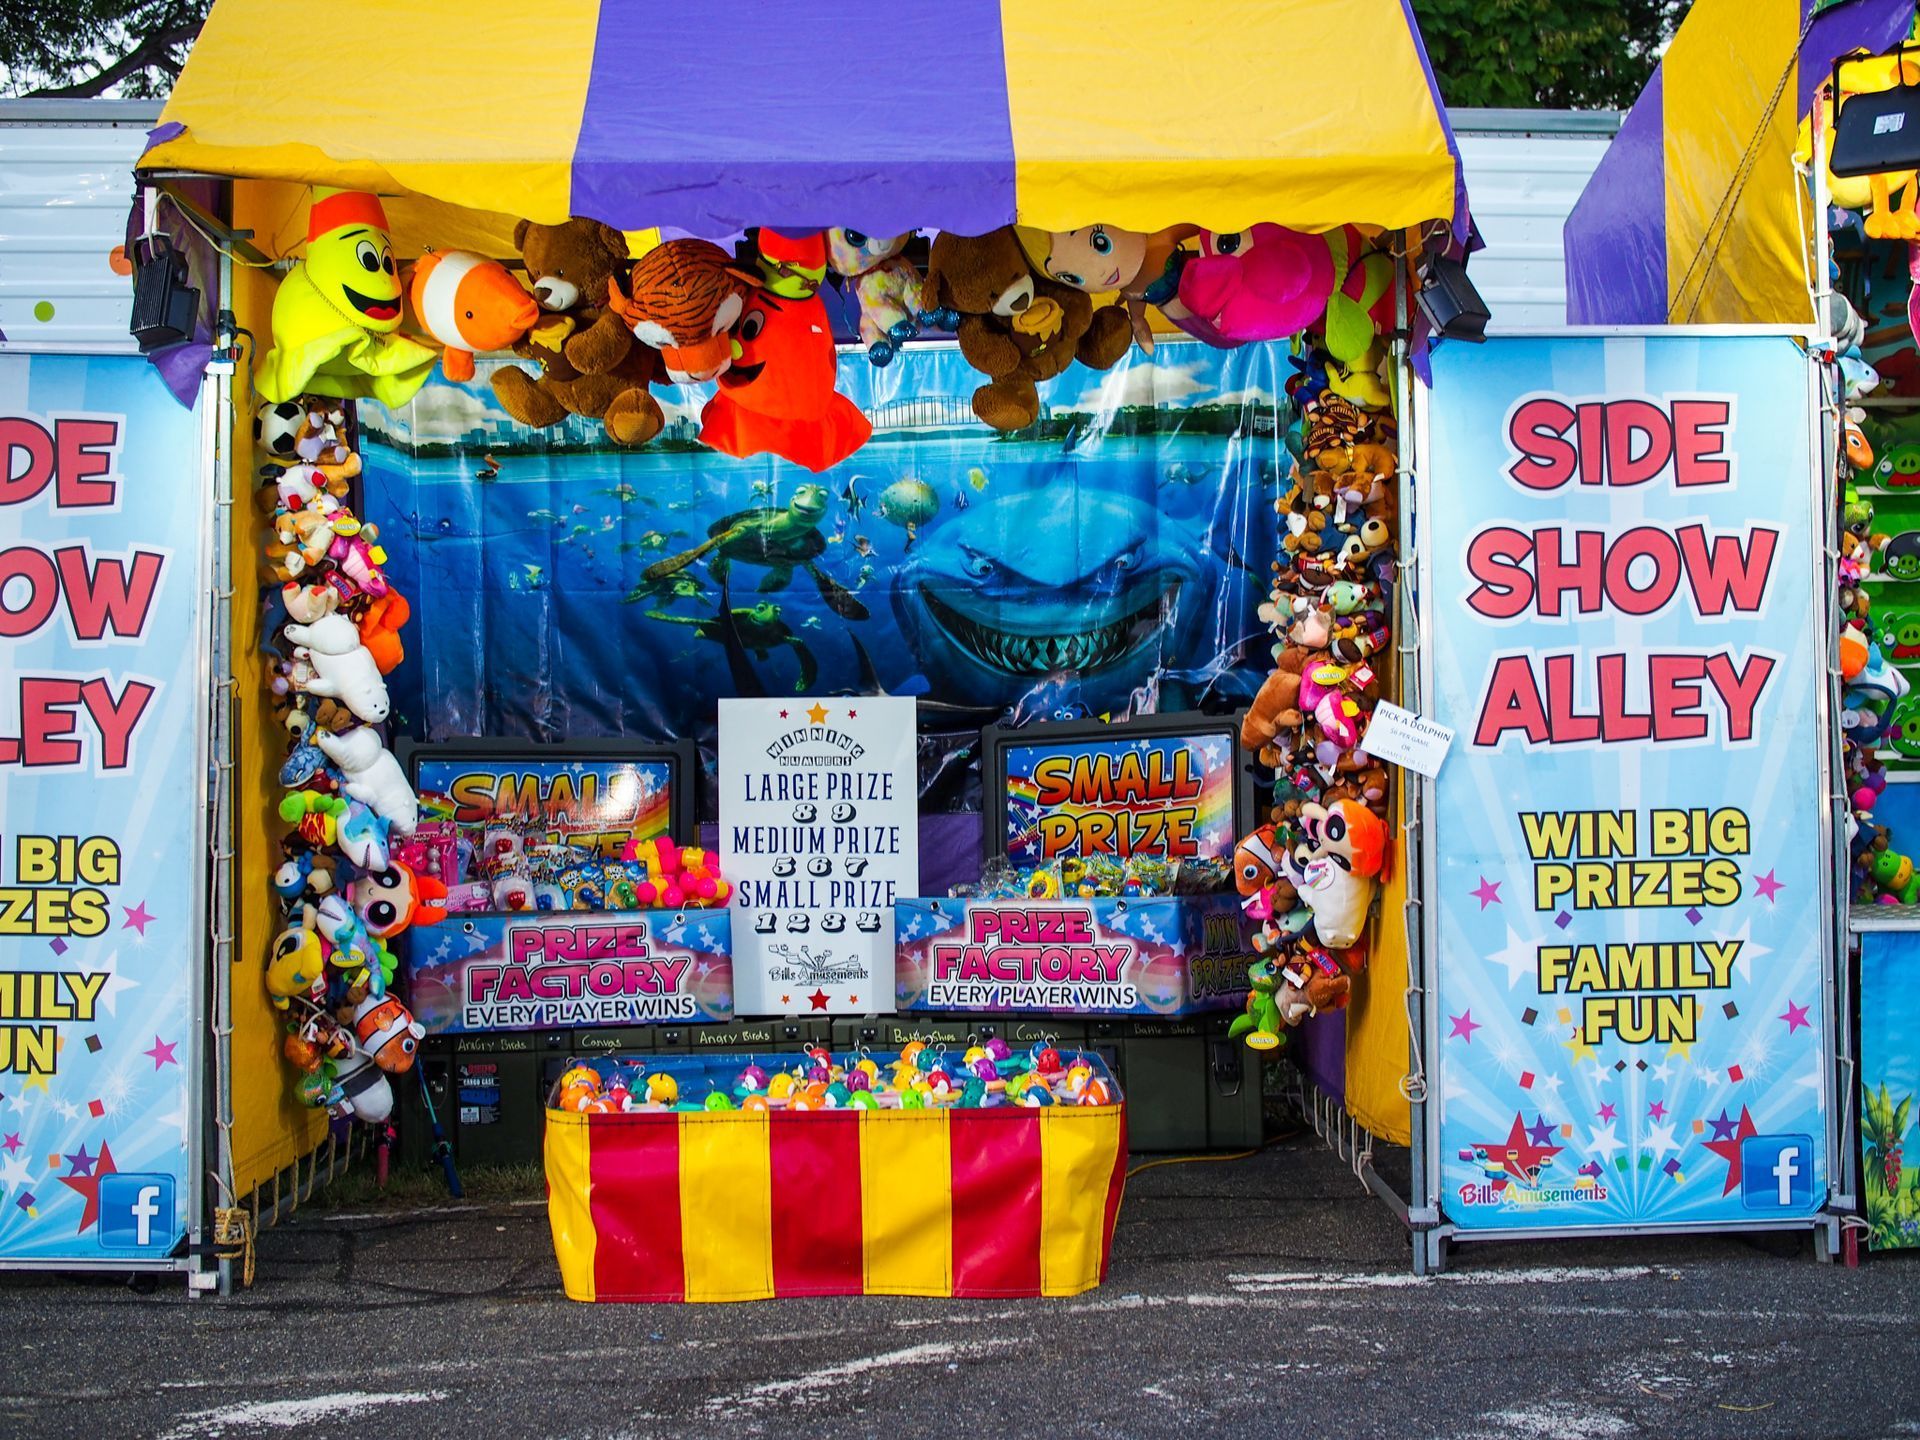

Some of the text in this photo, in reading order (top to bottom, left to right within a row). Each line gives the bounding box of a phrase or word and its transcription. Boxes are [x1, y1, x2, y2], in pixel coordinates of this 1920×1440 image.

[1509, 399, 1730, 490] SIDE
[1466, 524, 1779, 618] SHOW
[1473, 652, 1776, 746] ALLEY
[1380, 708, 1451, 742] PICK A DOLPHIN
[766, 728, 865, 760] WINNING
[1401, 743, 1411, 752] OR
[1411, 736, 1429, 748] GAME
[780, 756, 851, 766] NUMBERS
[744, 773, 892, 801] LARGE PRIZE
[1034, 750, 1201, 805] SMALL
[792, 803, 856, 823] 8 9
[732, 826, 899, 853] MEDIUM PRIZE
[1039, 809, 1198, 858] PRIZE
[1519, 807, 1750, 859] WIN BIG
[17, 835, 121, 885] BIG
[772, 857, 868, 877] 5 6 7
[739, 880, 896, 908] SMALL PRIZE
[1534, 858, 1741, 910] PRIZES
[755, 912, 882, 933] 1 2 3 4
[969, 909, 1093, 945] PRIZE
[1205, 915, 1240, 953] WIN
[510, 923, 649, 963] PRIZE
[467, 957, 690, 1004] FACTORY
[769, 965, 869, 981] Bills Amusements
[933, 945, 1131, 984] FACTORY
[1191, 956, 1256, 999] PRIZES
[1538, 940, 1744, 994] FAMILY
[466, 997, 694, 1025] EVERY PLAYER WINS
[931, 986, 1135, 1006] EVERY PLAYER WINS
[1583, 994, 1696, 1045] FUN
[501, 1038, 527, 1050] Birds
[581, 1034, 622, 1048] Canvas
[700, 1030, 770, 1045] Angry Birds
[932, 1030, 956, 1042] Ships
[1458, 1181, 1607, 1206] Bills Amusements
